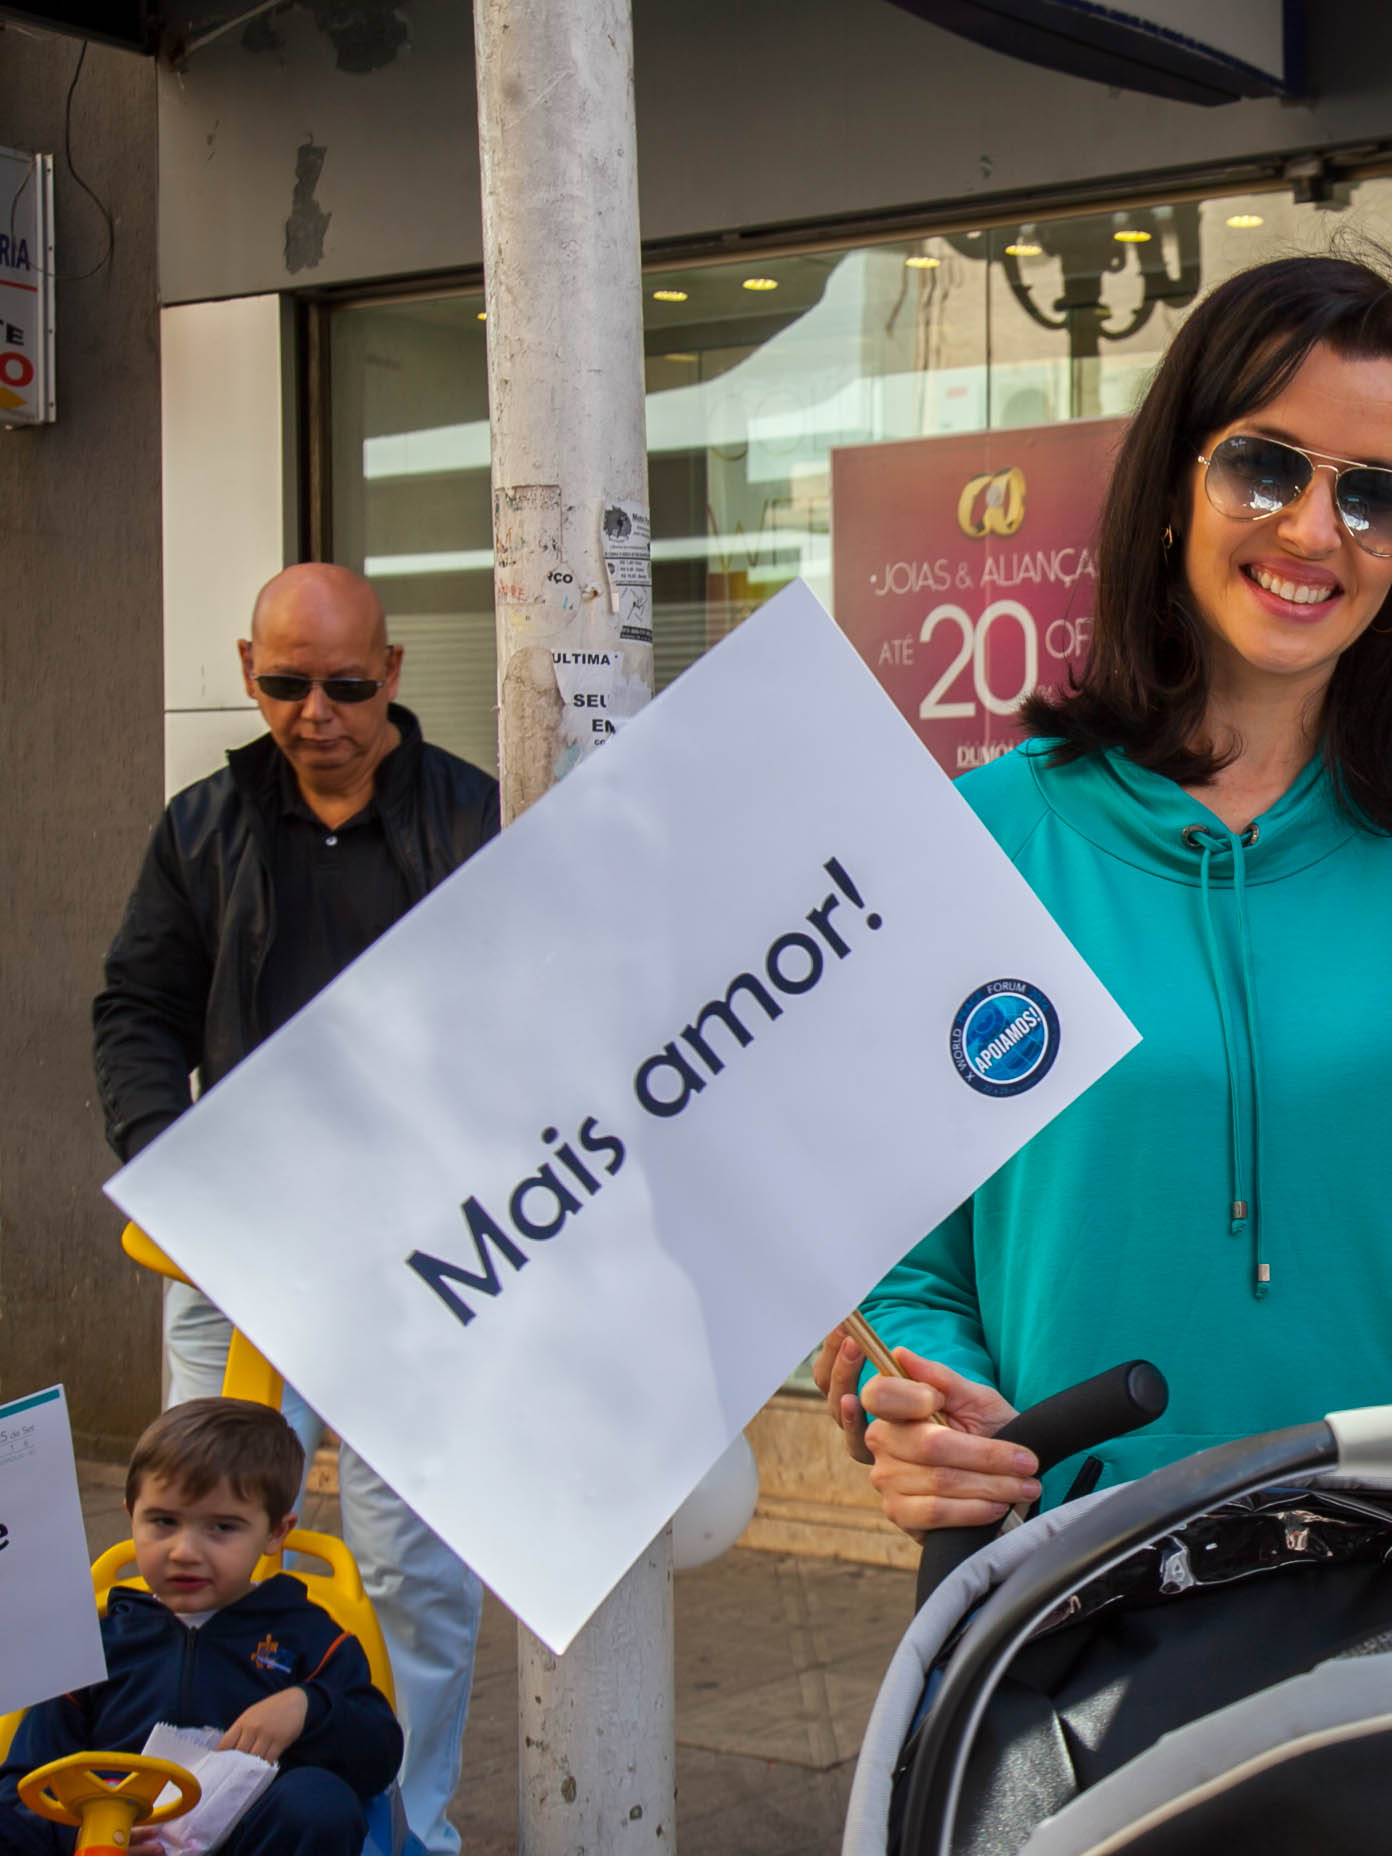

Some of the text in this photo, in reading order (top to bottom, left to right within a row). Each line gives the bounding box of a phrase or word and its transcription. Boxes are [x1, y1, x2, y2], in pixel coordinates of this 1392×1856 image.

[955, 565, 973, 589] &
[551, 652, 611, 666] ULTIMA
[878, 634, 915, 666] ATÉ
[919, 600, 1038, 720] 20
[974, 1006, 1041, 1074] APOIAMOS!
[405, 856, 884, 1327] Mais amor!
